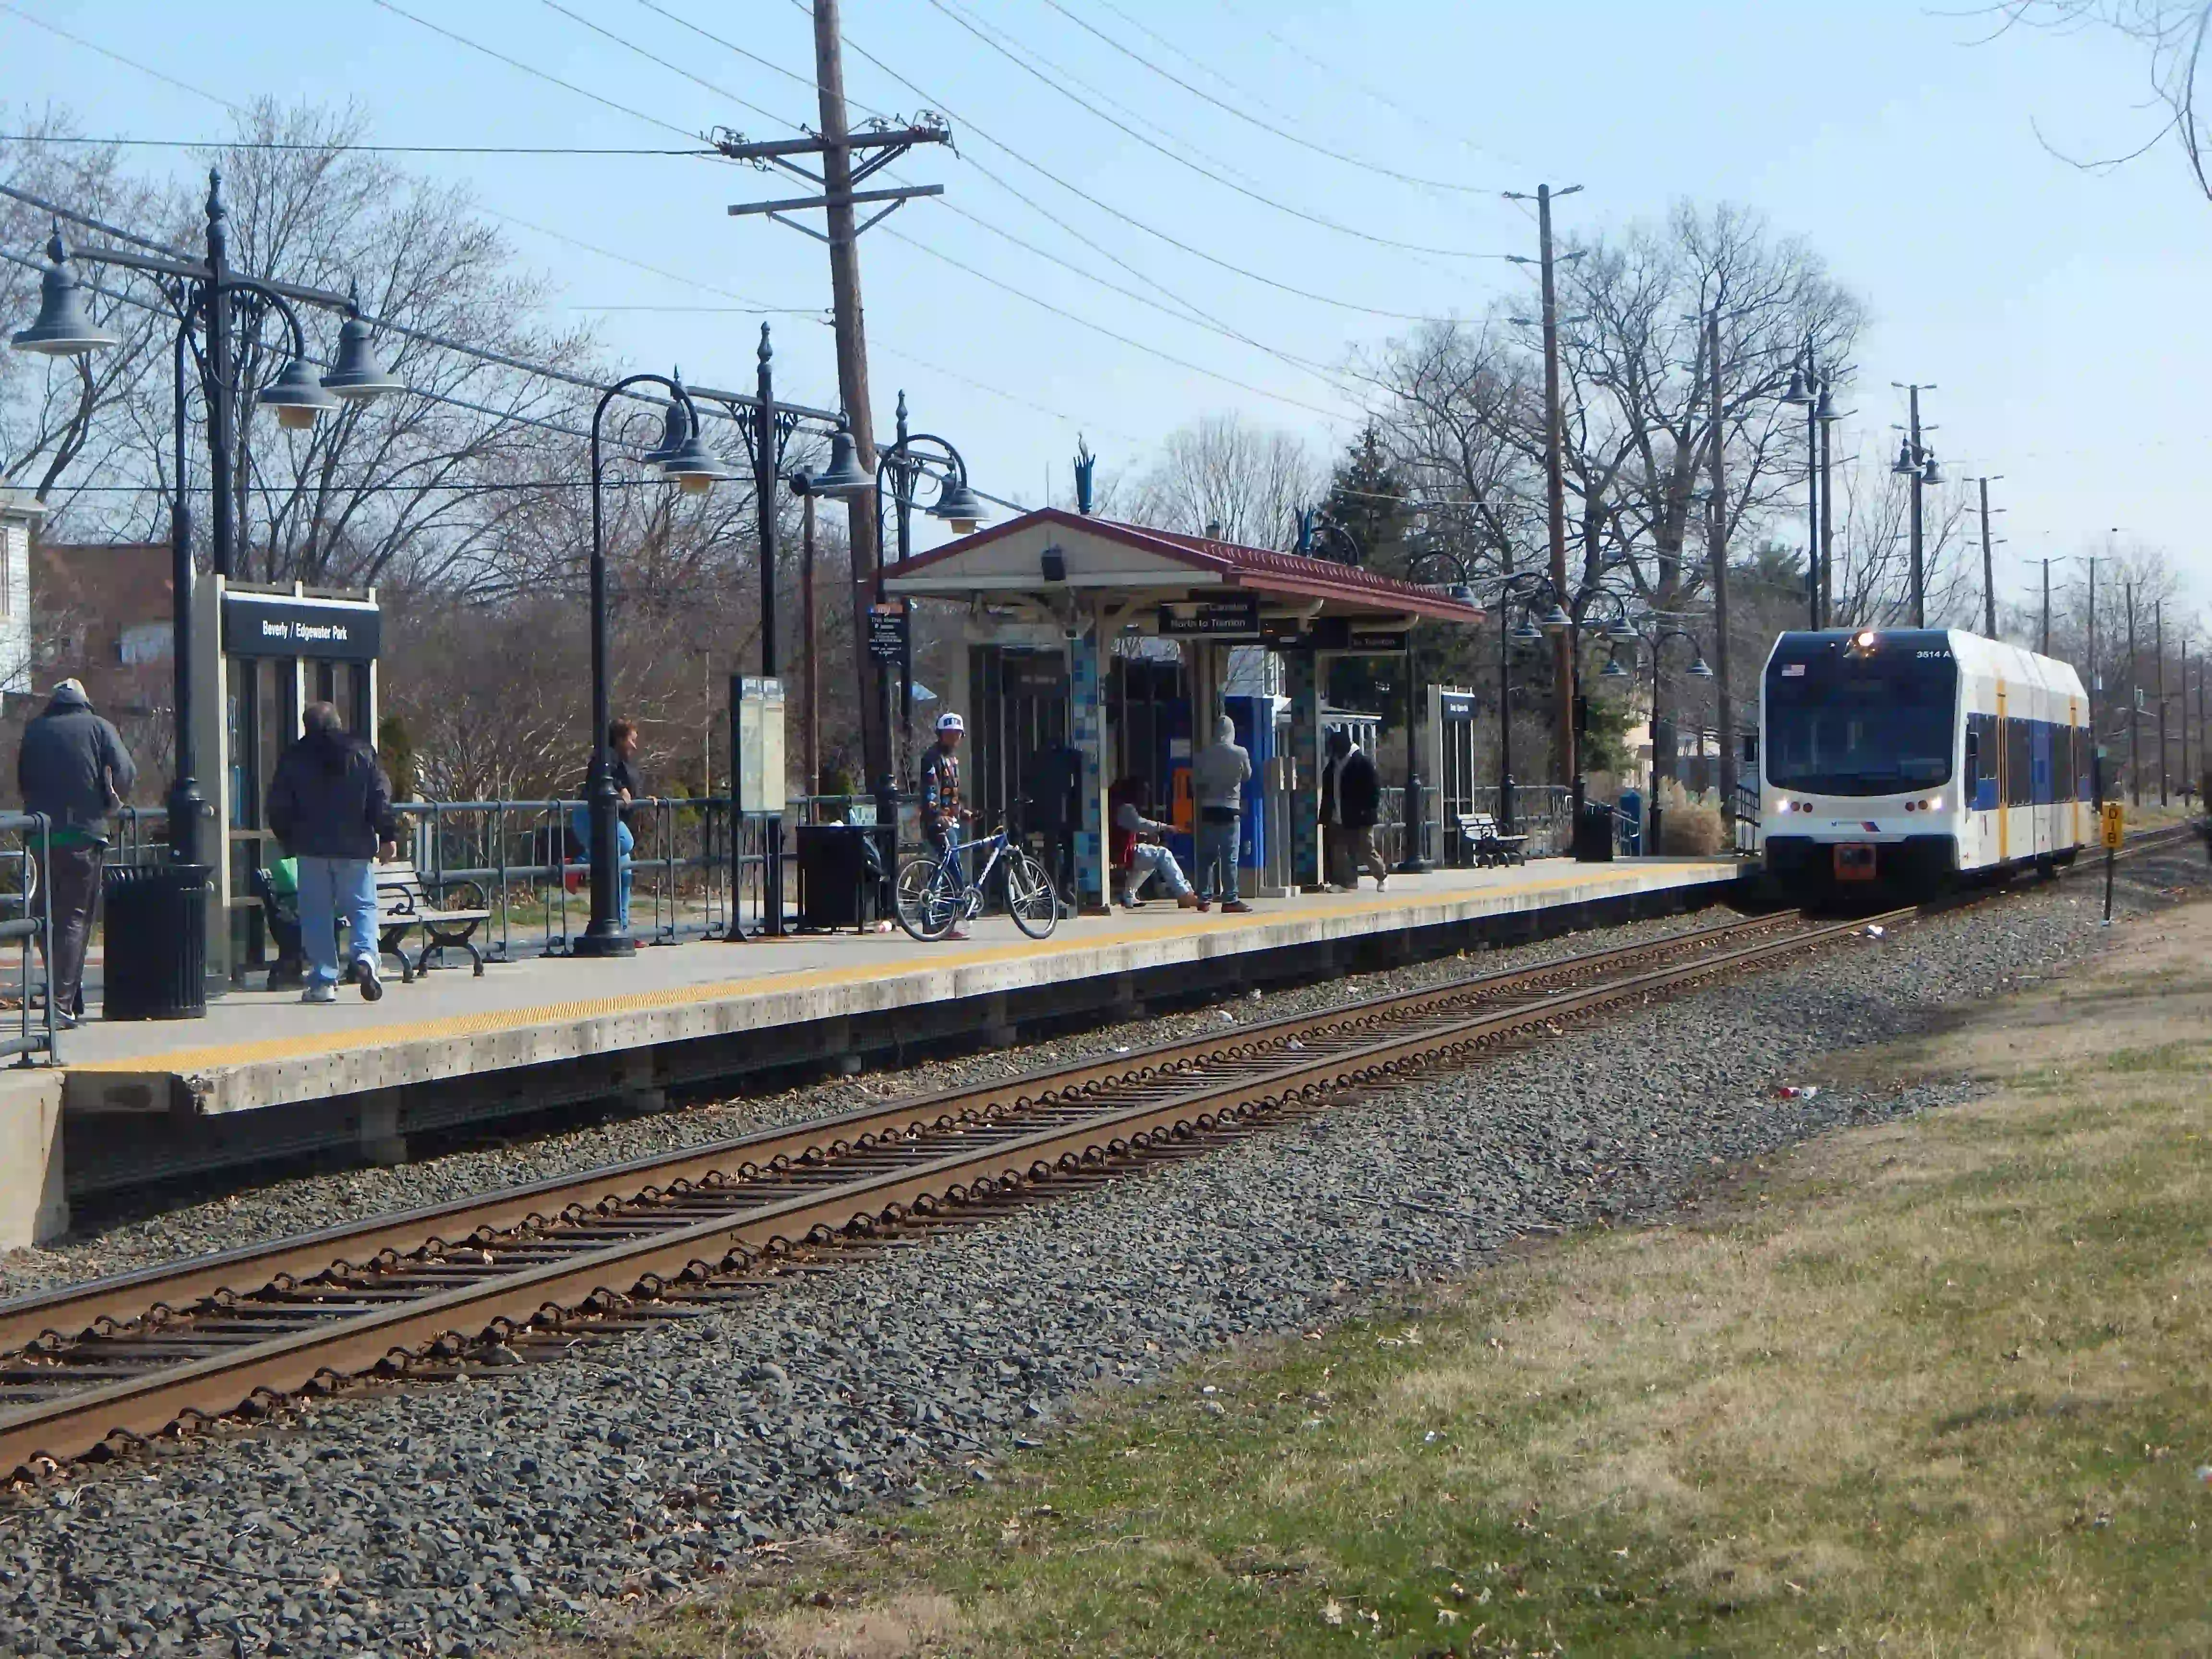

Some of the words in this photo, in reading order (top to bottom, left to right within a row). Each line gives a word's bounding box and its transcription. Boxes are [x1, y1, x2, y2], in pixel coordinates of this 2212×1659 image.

[1171, 619, 1196, 628] North
[1199, 619, 1209, 627] to
[1211, 618, 1246, 627] Trenton
[263, 620, 288, 639] Beverly
[290, 621, 294, 638] /
[296, 622, 331, 641] Edgewater
[333, 625, 348, 640] Park
[1916, 650, 1940, 658] 3514
